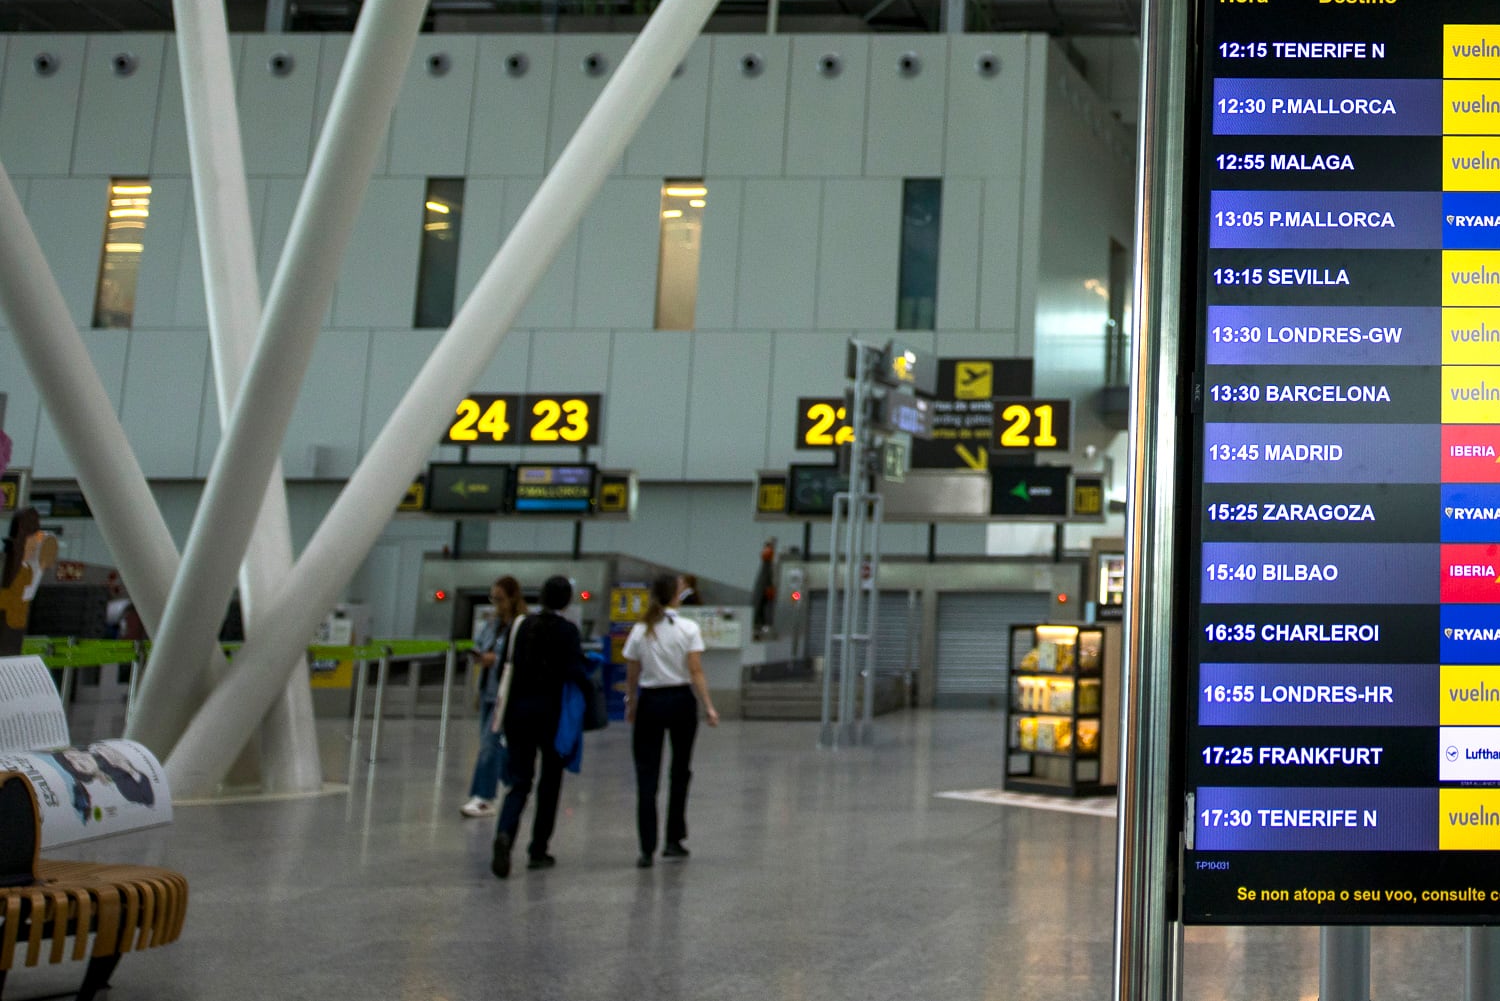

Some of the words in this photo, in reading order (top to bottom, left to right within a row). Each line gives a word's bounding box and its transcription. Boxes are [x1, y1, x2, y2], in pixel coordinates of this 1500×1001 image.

[1219, 42, 1268, 58] 12:15
[1272, 42, 1366, 59] TENERIFE
[1372, 43, 1385, 59] N
[1217, 98, 1266, 114] 12:30
[1271, 98, 1397, 115] P.MALLORCA
[1216, 154, 1265, 170] 12:55
[1270, 154, 1355, 170] MALAGA
[1214, 211, 1264, 227] 13:05
[1269, 211, 1396, 228] P.MALLORCA
[1213, 268, 1263, 285] 13:15
[1267, 268, 1350, 285] SEVILLA
[1212, 326, 1262, 343] 13:30
[1267, 326, 1403, 344] LONDRES-GW
[1210, 385, 1260, 402] 13:30
[1266, 385, 1391, 402] BARCELONA
[449, 399, 509, 441] 24
[530, 399, 588, 441] 23
[1001, 405, 1057, 447] 21
[1209, 444, 1259, 461] 13:45
[1264, 444, 1343, 461] MADRID
[1450, 445, 1496, 457] IBERIA
[1208, 503, 1258, 521] 15:25
[1262, 504, 1376, 521] ZARAGOZA
[1206, 563, 1257, 581] 15:40
[1262, 564, 1338, 581] BILBAO
[1449, 565, 1496, 577] IBERIA
[1205, 623, 1256, 641] 16:35
[1261, 624, 1379, 642] CHARLEROI
[1203, 685, 1255, 703] 16:55
[1260, 685, 1394, 703] LONDRES-HR
[1202, 746, 1254, 765] 17:25
[1259, 747, 1383, 765] FRANKFURT
[1201, 809, 1252, 827] 17:30
[1257, 809, 1358, 827] TENERIFE
[1363, 810, 1377, 827] N
[1237, 886, 1257, 901] Se
[1260, 890, 1290, 901] non
[1293, 887, 1336, 905] atopa
[1339, 890, 1350, 901] o
[1353, 890, 1381, 901] seu
[1384, 890, 1417, 904] voo,
[1421, 887, 1486, 902] consulte
